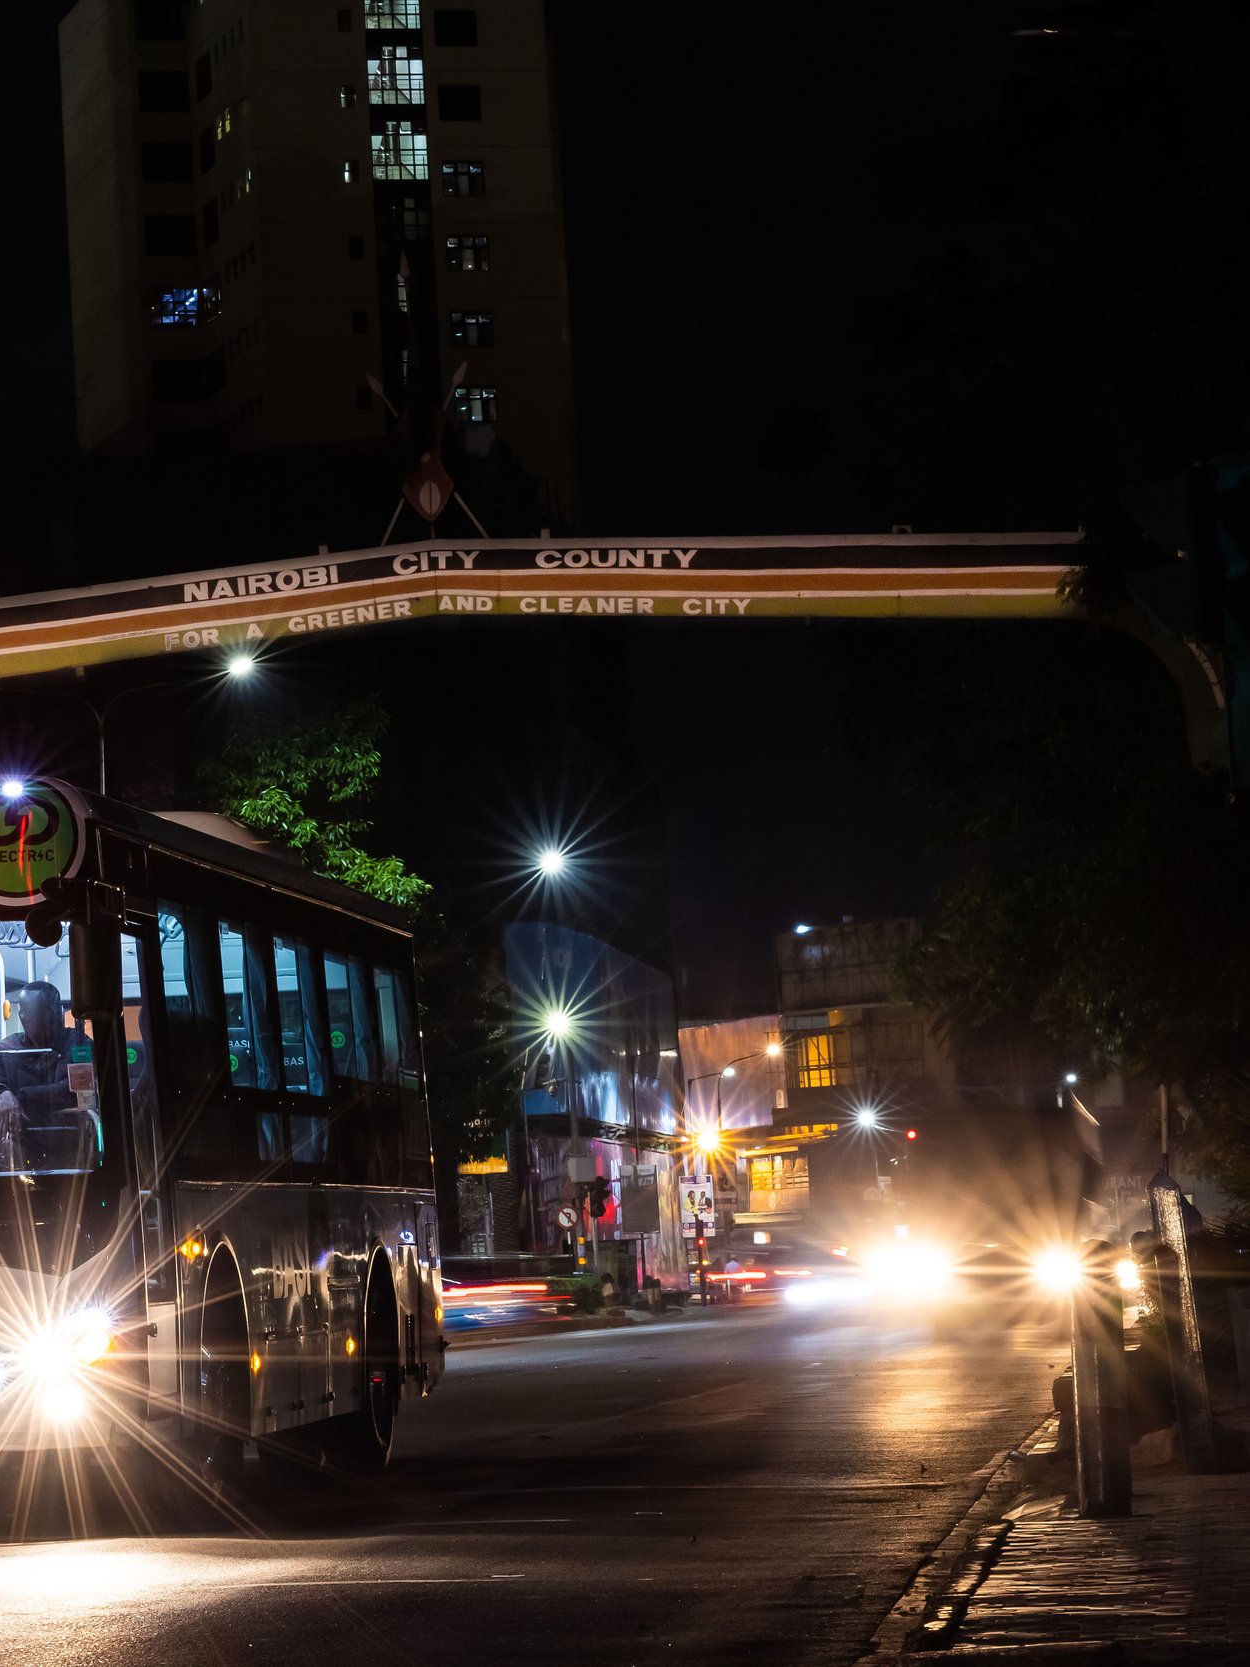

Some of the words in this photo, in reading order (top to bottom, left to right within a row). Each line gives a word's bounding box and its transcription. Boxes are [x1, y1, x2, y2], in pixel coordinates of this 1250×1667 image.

[183, 565, 339, 602] NAIROBI
[393, 551, 480, 576] CITY
[535, 549, 699, 569] COUNTY
[165, 628, 220, 651] FOR
[245, 623, 264, 641] A
[288, 600, 412, 633] GREENER
[439, 595, 493, 612] AND
[519, 597, 654, 614] CLEANER
[682, 598, 751, 615] CITY
